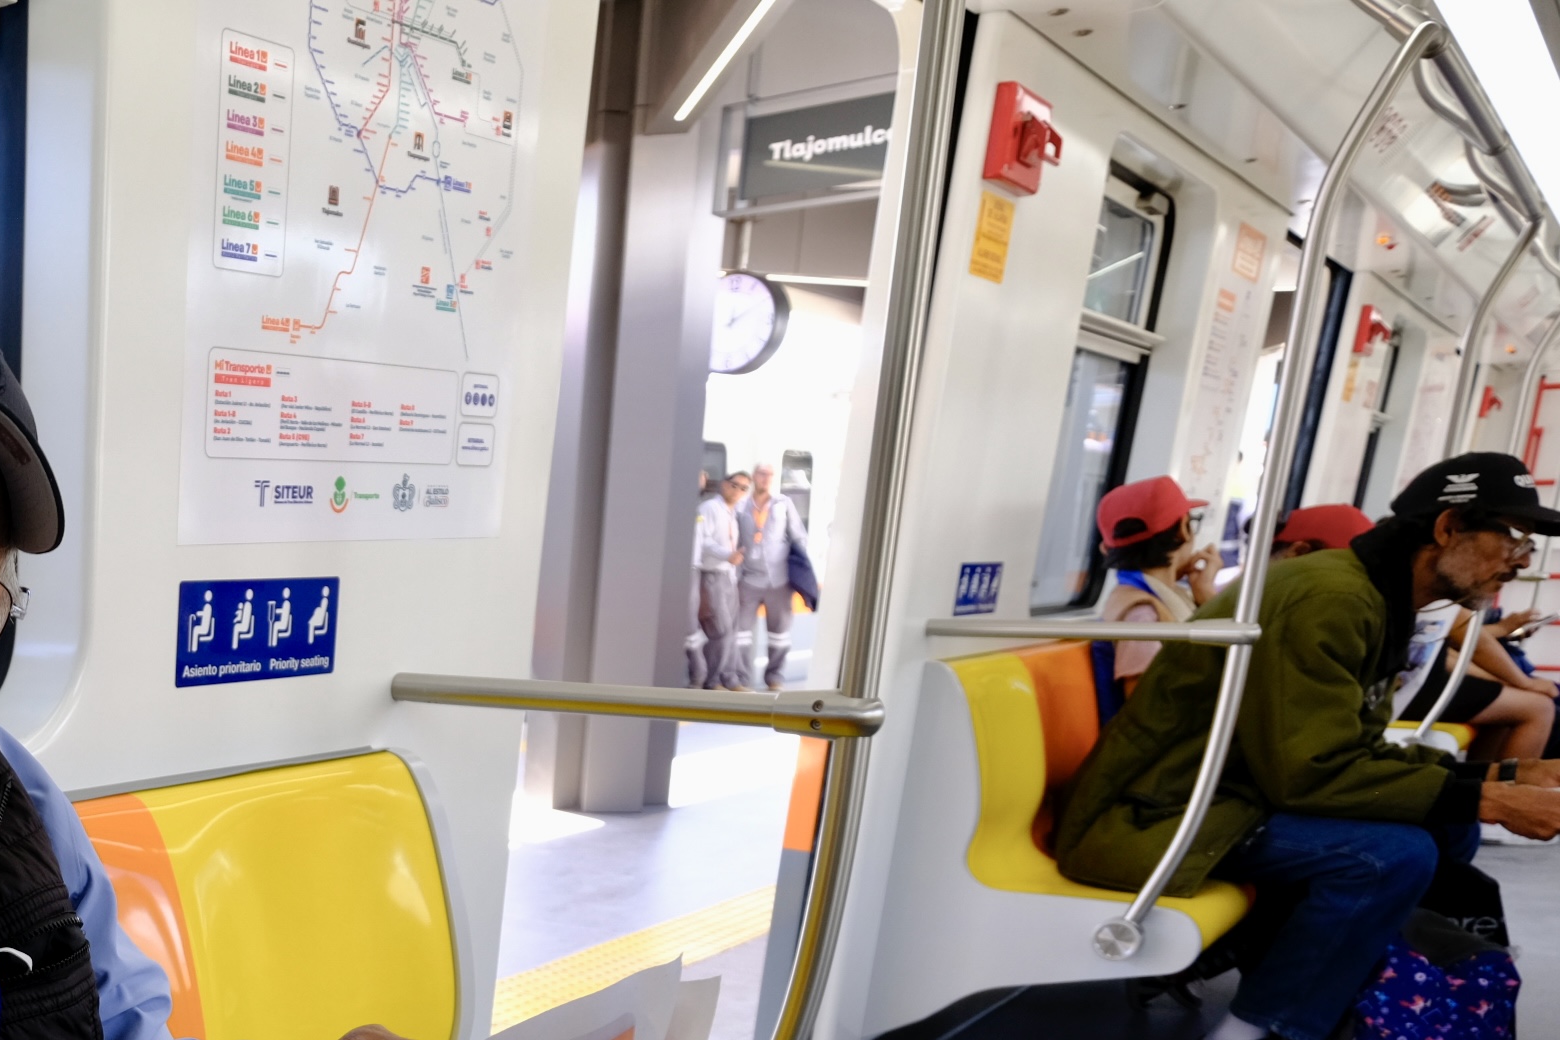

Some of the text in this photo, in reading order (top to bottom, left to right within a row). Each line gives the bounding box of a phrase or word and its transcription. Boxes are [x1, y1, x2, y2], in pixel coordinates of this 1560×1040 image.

[229, 40, 260, 61] Línea 1
[228, 74, 259, 94] Línea 2
[226, 108, 258, 128] Línea 3
[225, 141, 257, 158] Línea 4
[223, 174, 255, 191] Línea 5
[222, 205, 253, 222] Línea 6
[221, 238, 251, 254] Línea 7
[261, 314, 280, 327] Línea
[225, 360, 266, 375] Transporte
[214, 390, 227, 398] Ruta
[281, 395, 293, 403] Ruta
[351, 400, 363, 408] Ruta
[214, 409, 227, 417] Ruta
[279, 411, 292, 419] Ruta
[350, 416, 362, 424] Ruta
[213, 427, 227, 435] Ruta
[273, 485, 314, 500] SITEUR
[353, 491, 380, 500] Transporte
[432, 487, 449, 496] ESTILO
[182, 655, 330, 679] Asiento prioritario Priority seating
